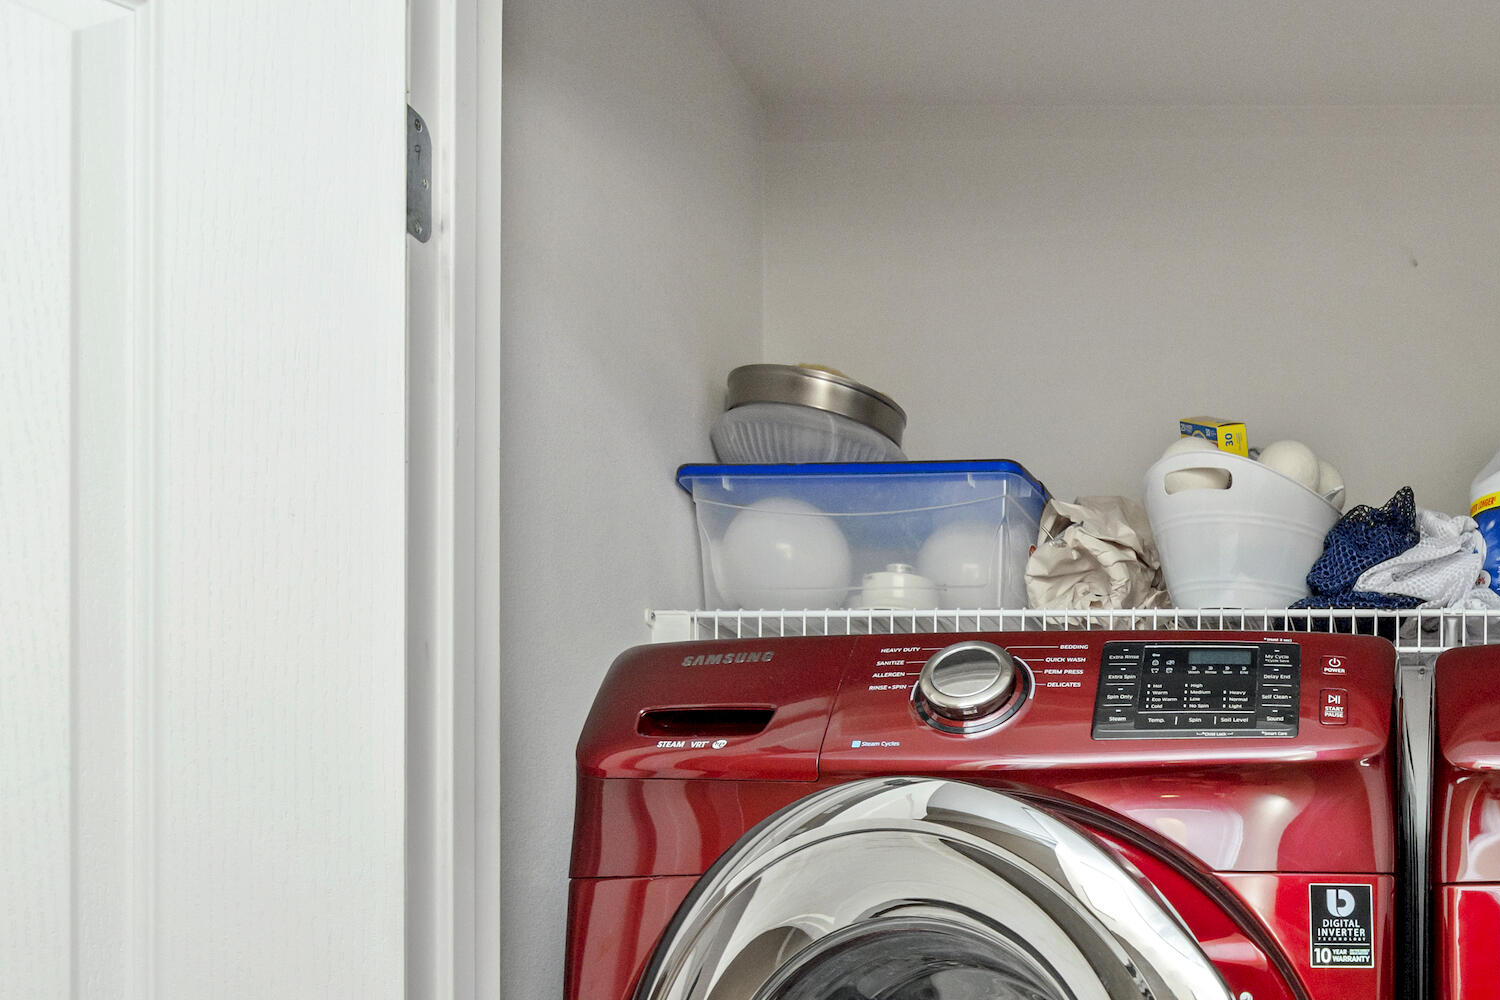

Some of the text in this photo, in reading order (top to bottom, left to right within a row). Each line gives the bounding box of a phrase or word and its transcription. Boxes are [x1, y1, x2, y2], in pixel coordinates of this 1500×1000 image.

[1225, 433, 1233, 446] 30
[682, 651, 775, 667] SAMSUNG
[656, 741, 685, 749] STEAM
[1323, 919, 1360, 928] DIGITAL
[1318, 928, 1366, 936] INVERTER
[1314, 948, 1332, 964] 10
